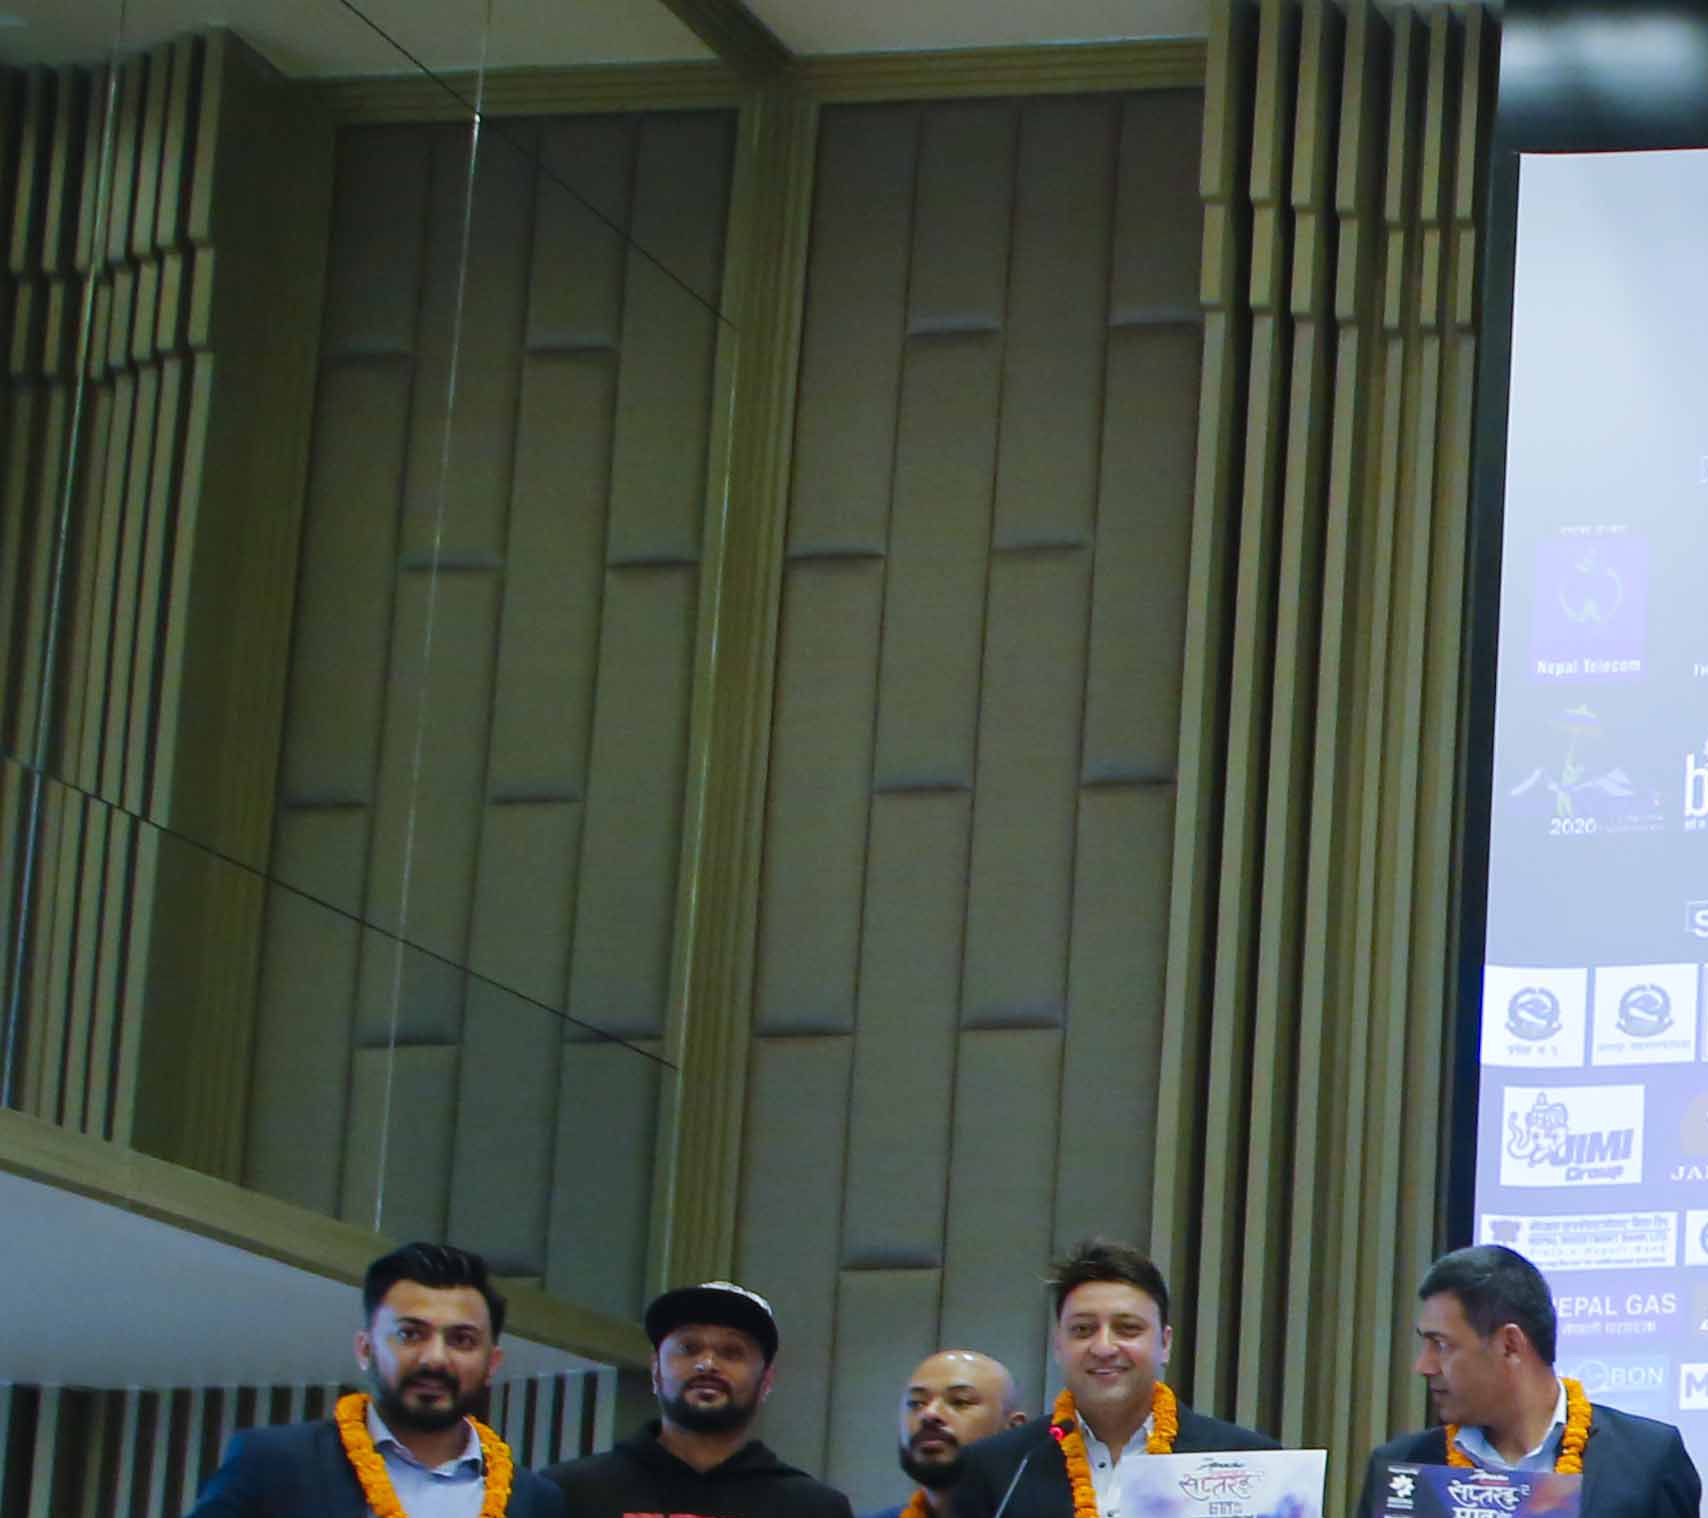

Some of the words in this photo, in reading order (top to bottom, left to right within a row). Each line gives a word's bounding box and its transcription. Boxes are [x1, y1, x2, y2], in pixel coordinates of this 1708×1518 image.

[1537, 657, 1579, 680] Nepal
[1583, 656, 1642, 675] Telecom
[1549, 819, 1598, 836] 2020
[1553, 1294, 1618, 1319] EPAL
[1625, 1291, 1680, 1315] GAS
